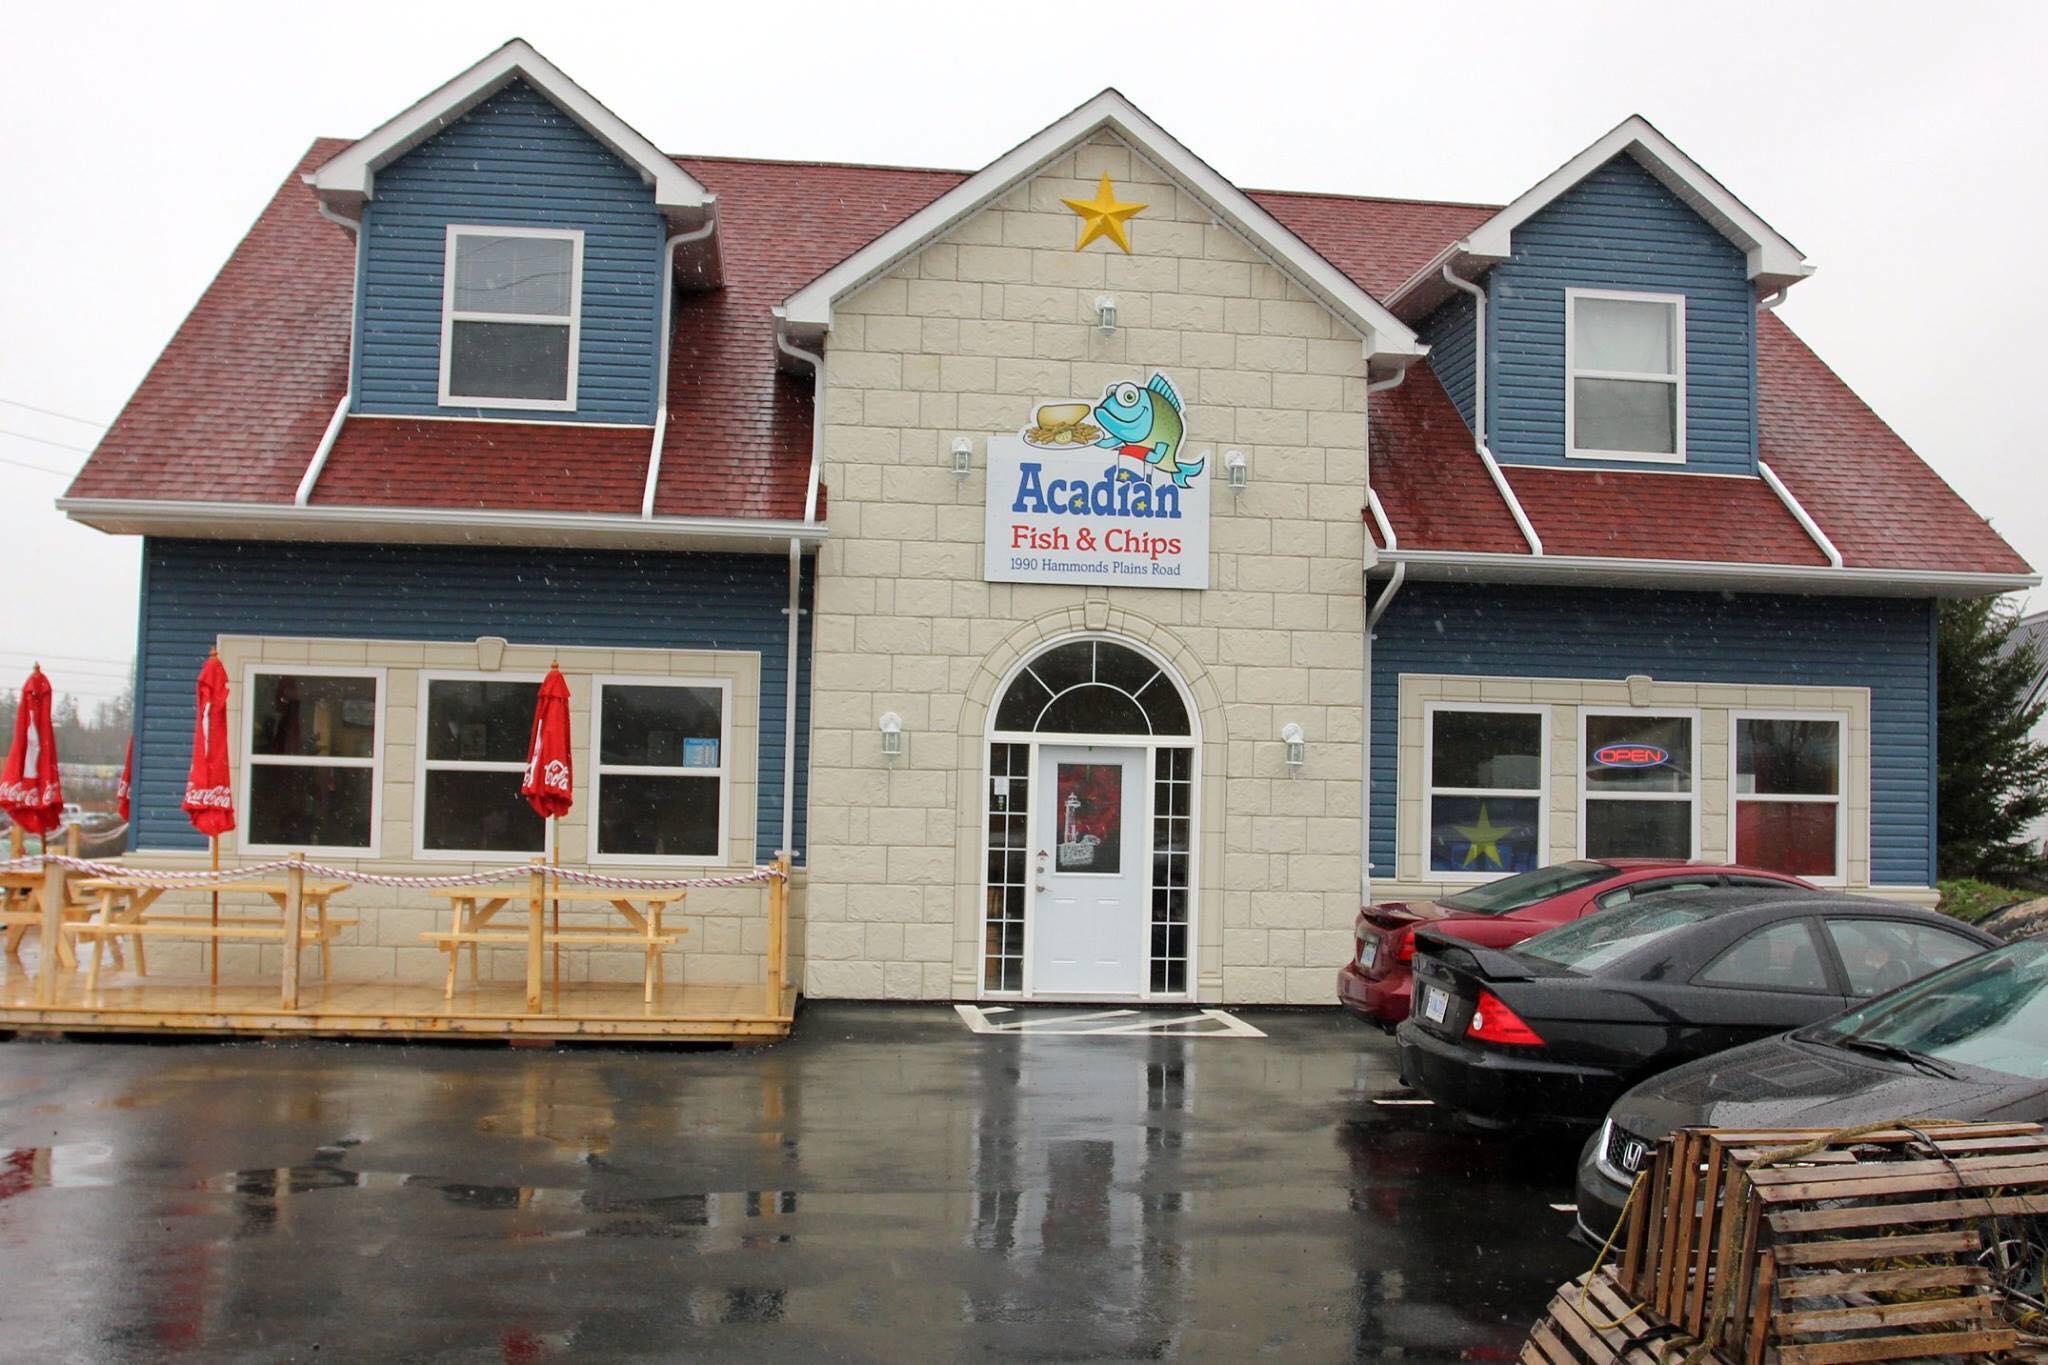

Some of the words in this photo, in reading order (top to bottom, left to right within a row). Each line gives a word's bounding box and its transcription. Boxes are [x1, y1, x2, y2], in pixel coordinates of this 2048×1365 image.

[1012, 463, 1182, 519] Acadian
[1011, 525, 1069, 550] Fish
[1076, 527, 1096, 551] &
[1105, 529, 1182, 560] Chips
[1011, 558, 1038, 570] 1990
[1042, 558, 1108, 573] Hammonds
[1113, 561, 1148, 575] Plains
[1152, 563, 1181, 576] Road
[1600, 749, 1662, 762] OPEN
